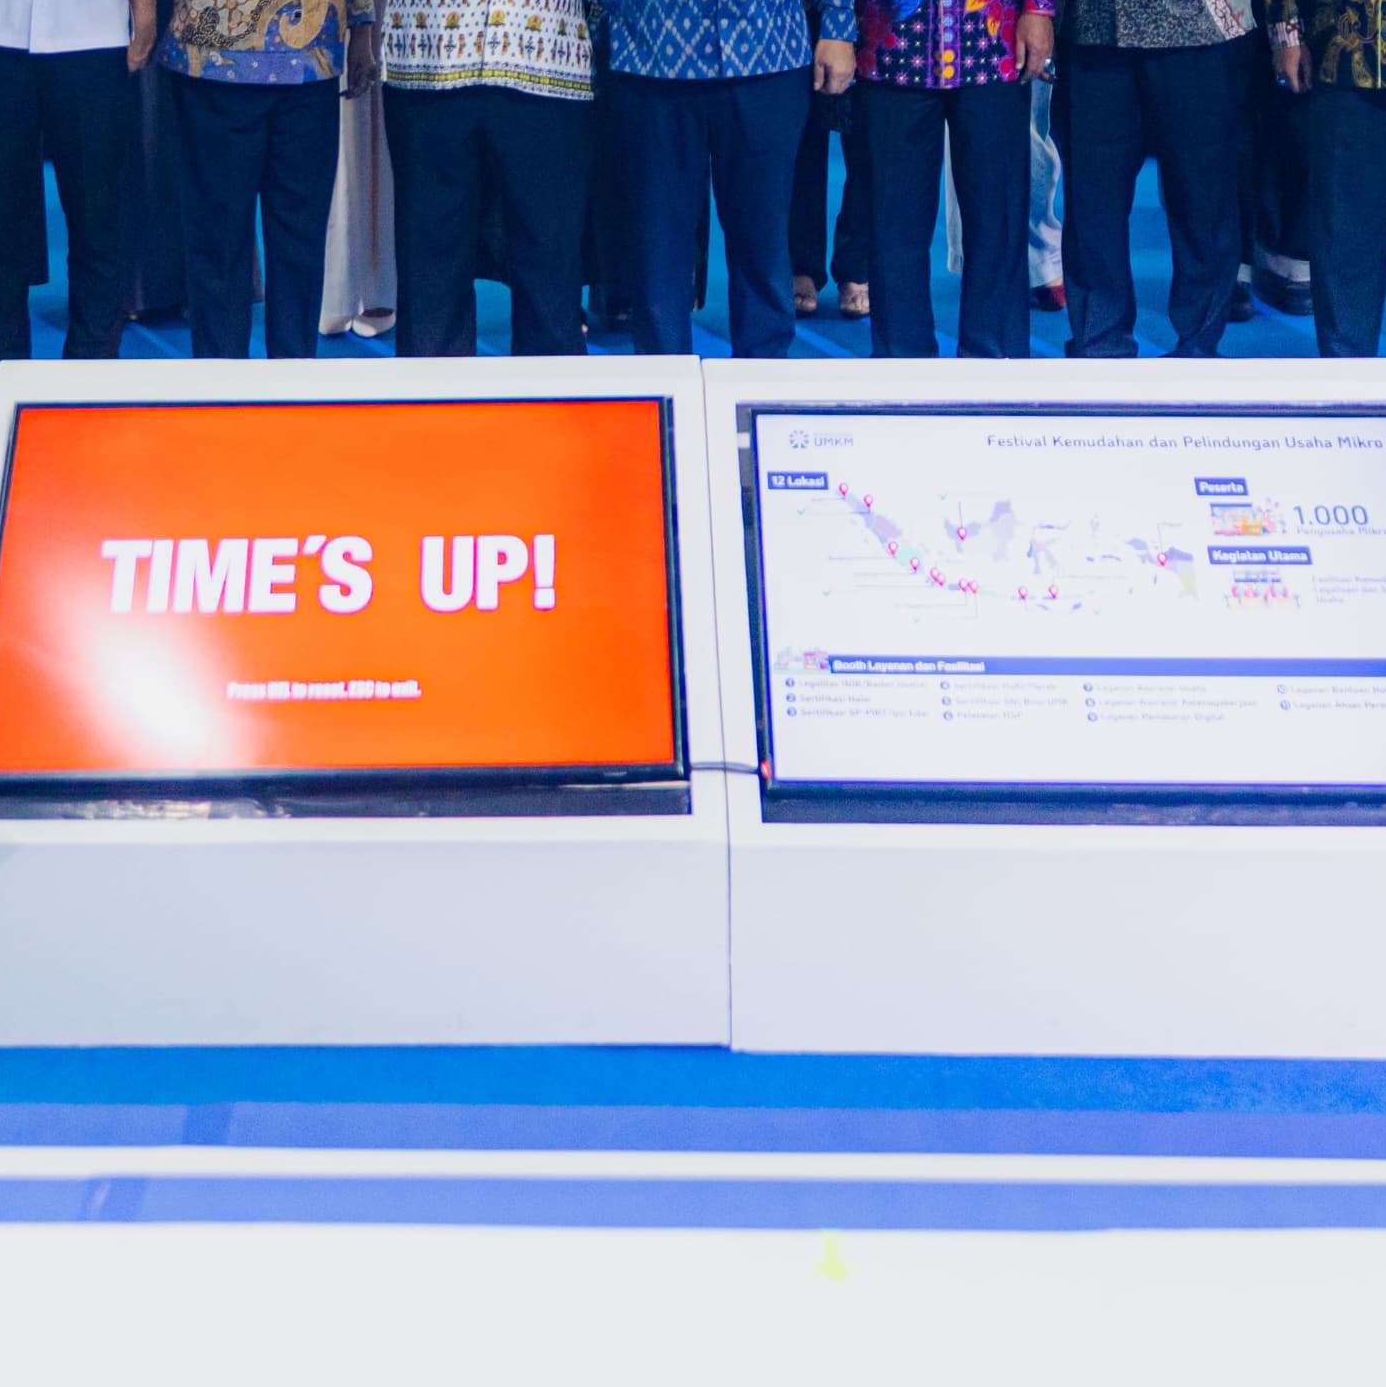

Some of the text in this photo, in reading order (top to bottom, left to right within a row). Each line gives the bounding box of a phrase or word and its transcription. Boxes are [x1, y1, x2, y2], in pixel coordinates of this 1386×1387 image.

[813, 436, 854, 447] UMKM
[987, 435, 1384, 451] Festival Kemudahan dan Pelindungan Usaha Mikro
[771, 475, 826, 487] 12 Lokasi
[1200, 482, 1244, 494] Peserta
[1293, 505, 1369, 526] 1.000
[1212, 550, 1308, 564] Kegiatan Utama
[420, 533, 557, 613] UP!
[833, 660, 866, 672] Booth
[867, 660, 914, 673] Layanan
[915, 660, 936, 672] dan
